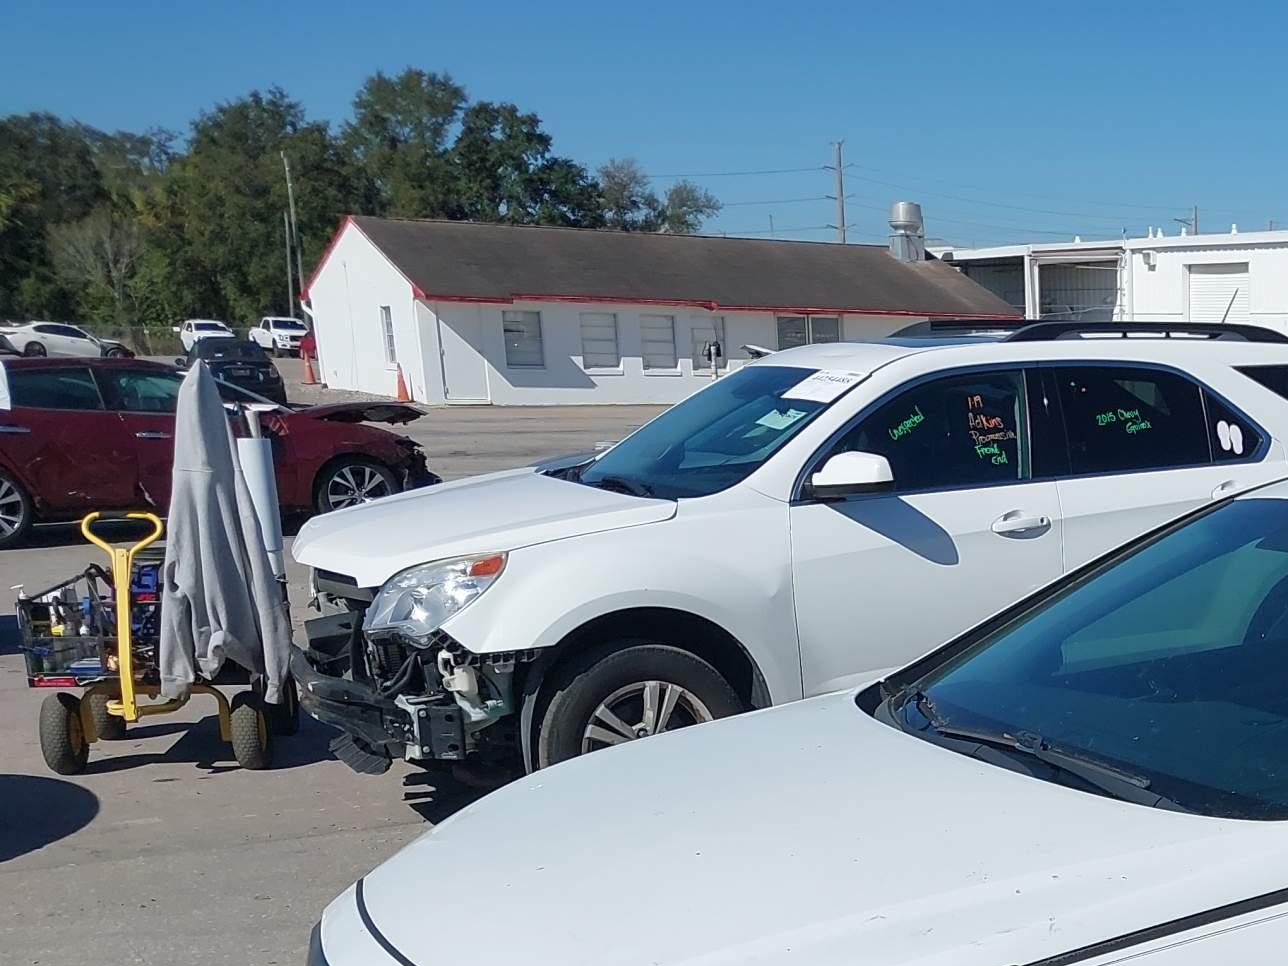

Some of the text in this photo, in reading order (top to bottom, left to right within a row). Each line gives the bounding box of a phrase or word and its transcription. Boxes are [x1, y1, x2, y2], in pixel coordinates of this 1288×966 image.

[1096, 408, 1141, 425] 2015 Chevy
[974, 443, 1000, 458] Front
[991, 451, 1008, 464] End
